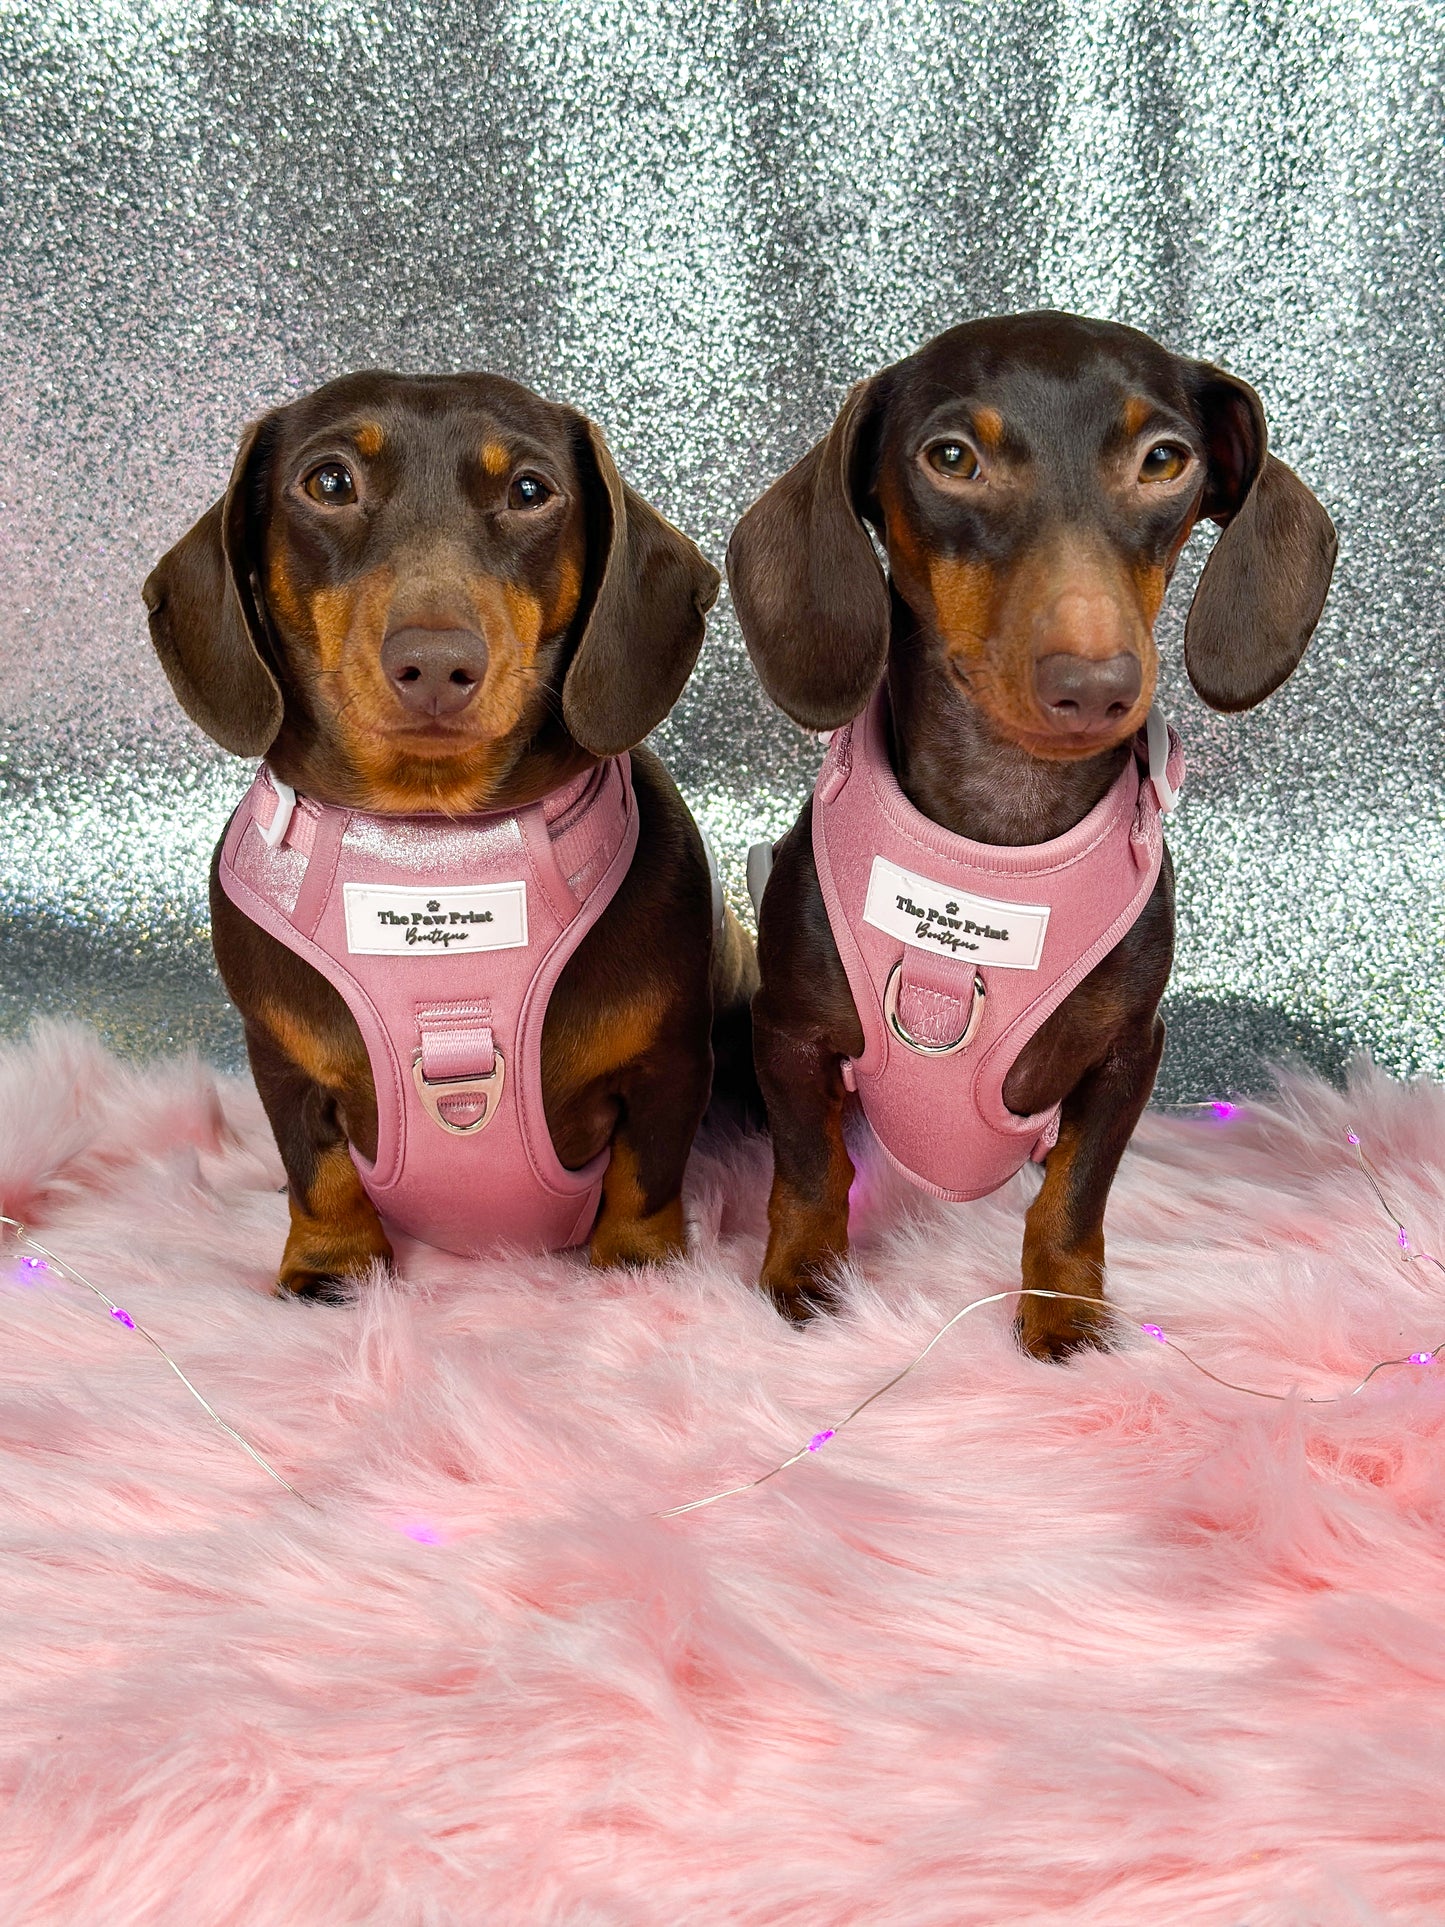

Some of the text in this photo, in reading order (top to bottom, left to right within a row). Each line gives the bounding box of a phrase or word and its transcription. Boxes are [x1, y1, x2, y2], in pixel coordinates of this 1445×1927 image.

[377, 910, 493, 925] The Paw Print
[895, 895, 1009, 941] The Paw Print
[405, 927, 468, 947] Boutique
[915, 921, 979, 952] Boutique
